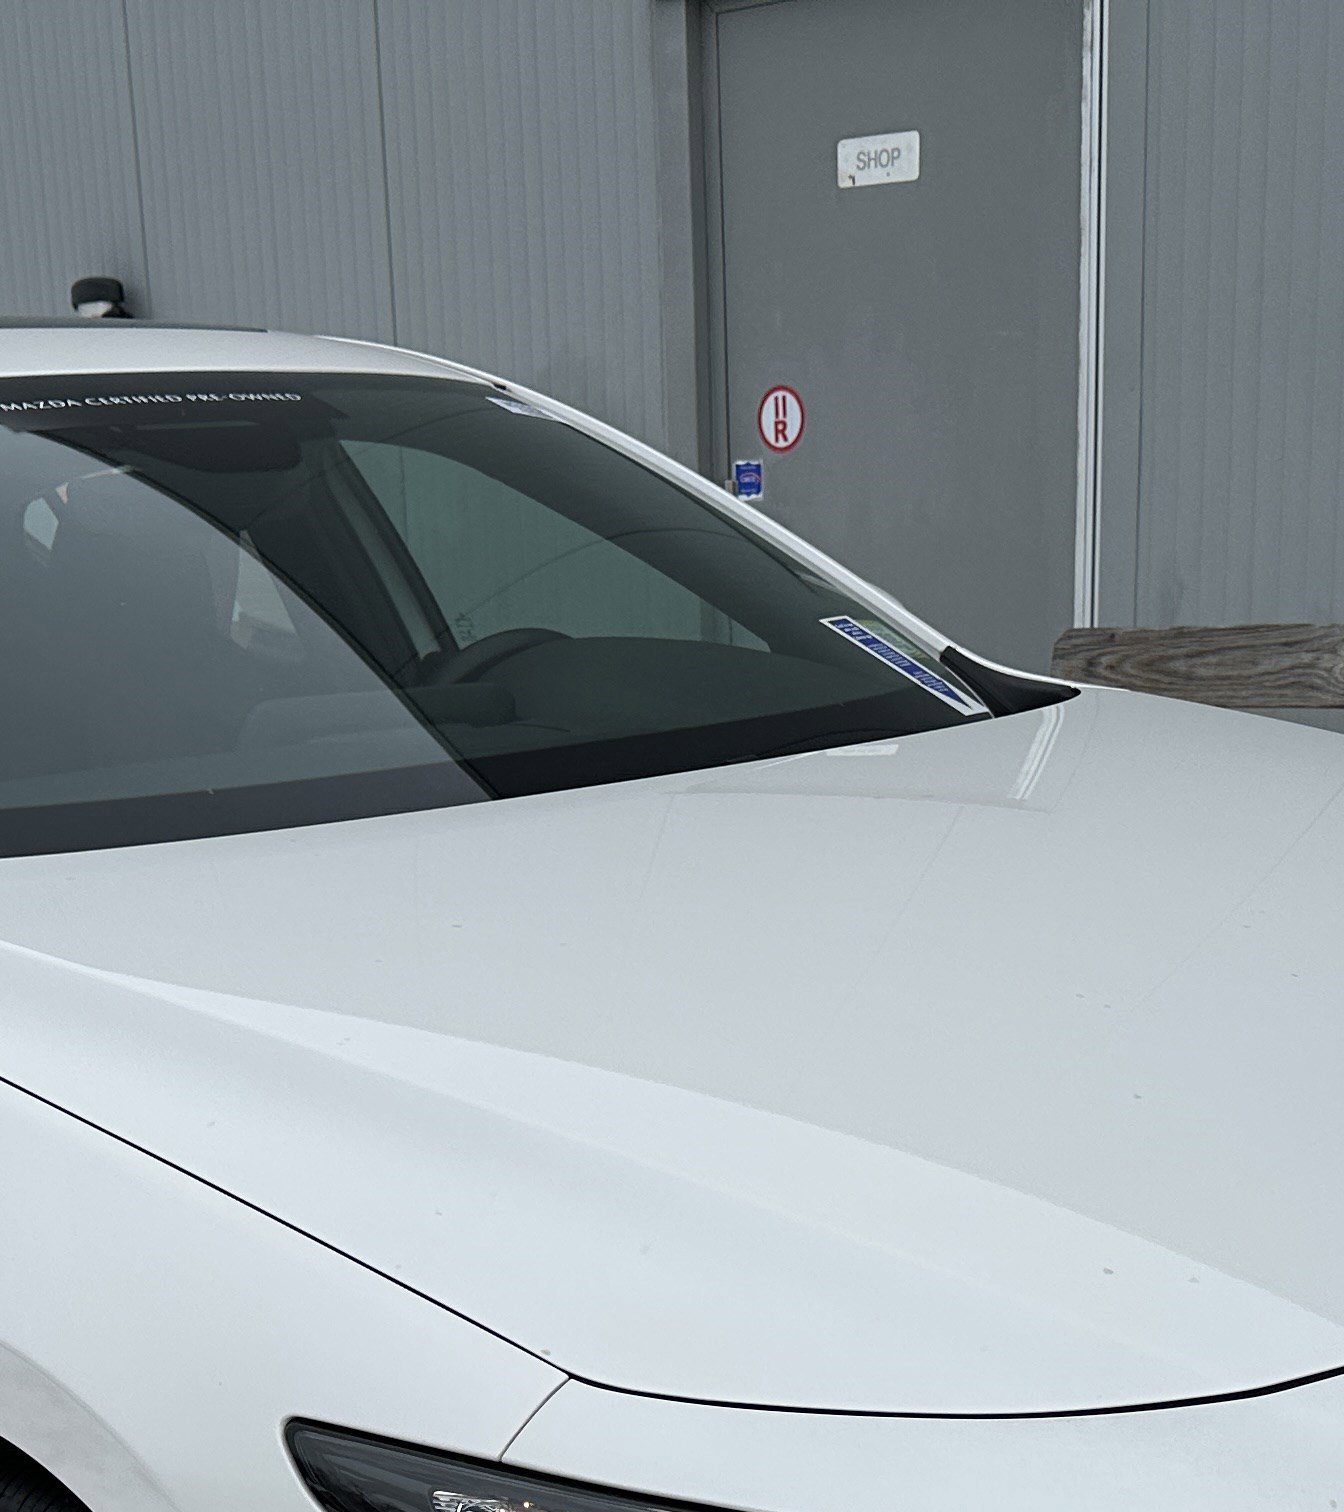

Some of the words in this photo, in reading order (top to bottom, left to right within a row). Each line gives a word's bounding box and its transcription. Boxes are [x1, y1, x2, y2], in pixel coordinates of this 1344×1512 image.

[856, 147, 901, 171] SHOP
[0, 399, 83, 413] MAZDA
[84, 393, 183, 407] CERTIFIED
[774, 420, 789, 443] R
